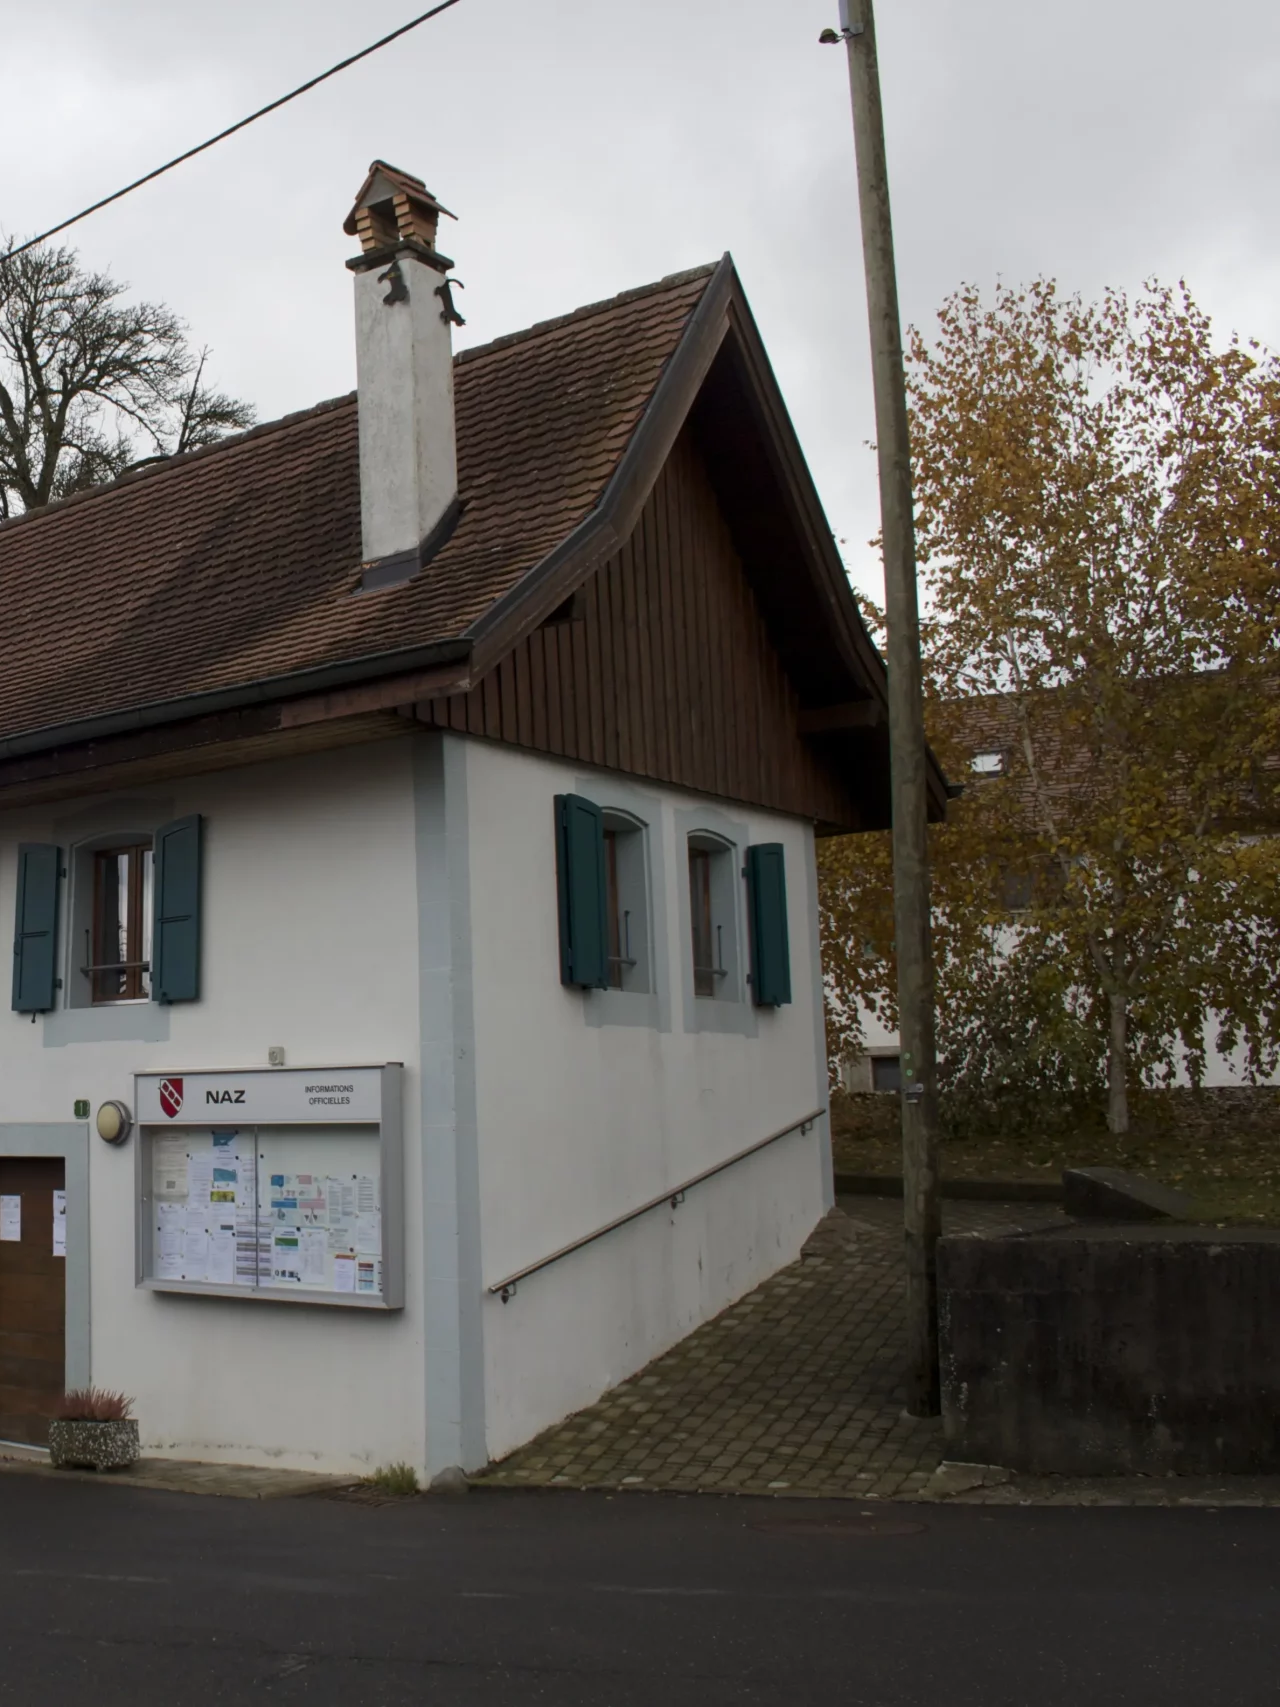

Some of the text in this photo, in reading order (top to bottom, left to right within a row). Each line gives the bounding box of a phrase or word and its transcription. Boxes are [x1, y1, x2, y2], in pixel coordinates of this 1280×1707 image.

[305, 1084, 353, 1093] INFORMATIONS
[206, 1090, 245, 1104] NAZ
[309, 1096, 350, 1105] OFFICIELLES
